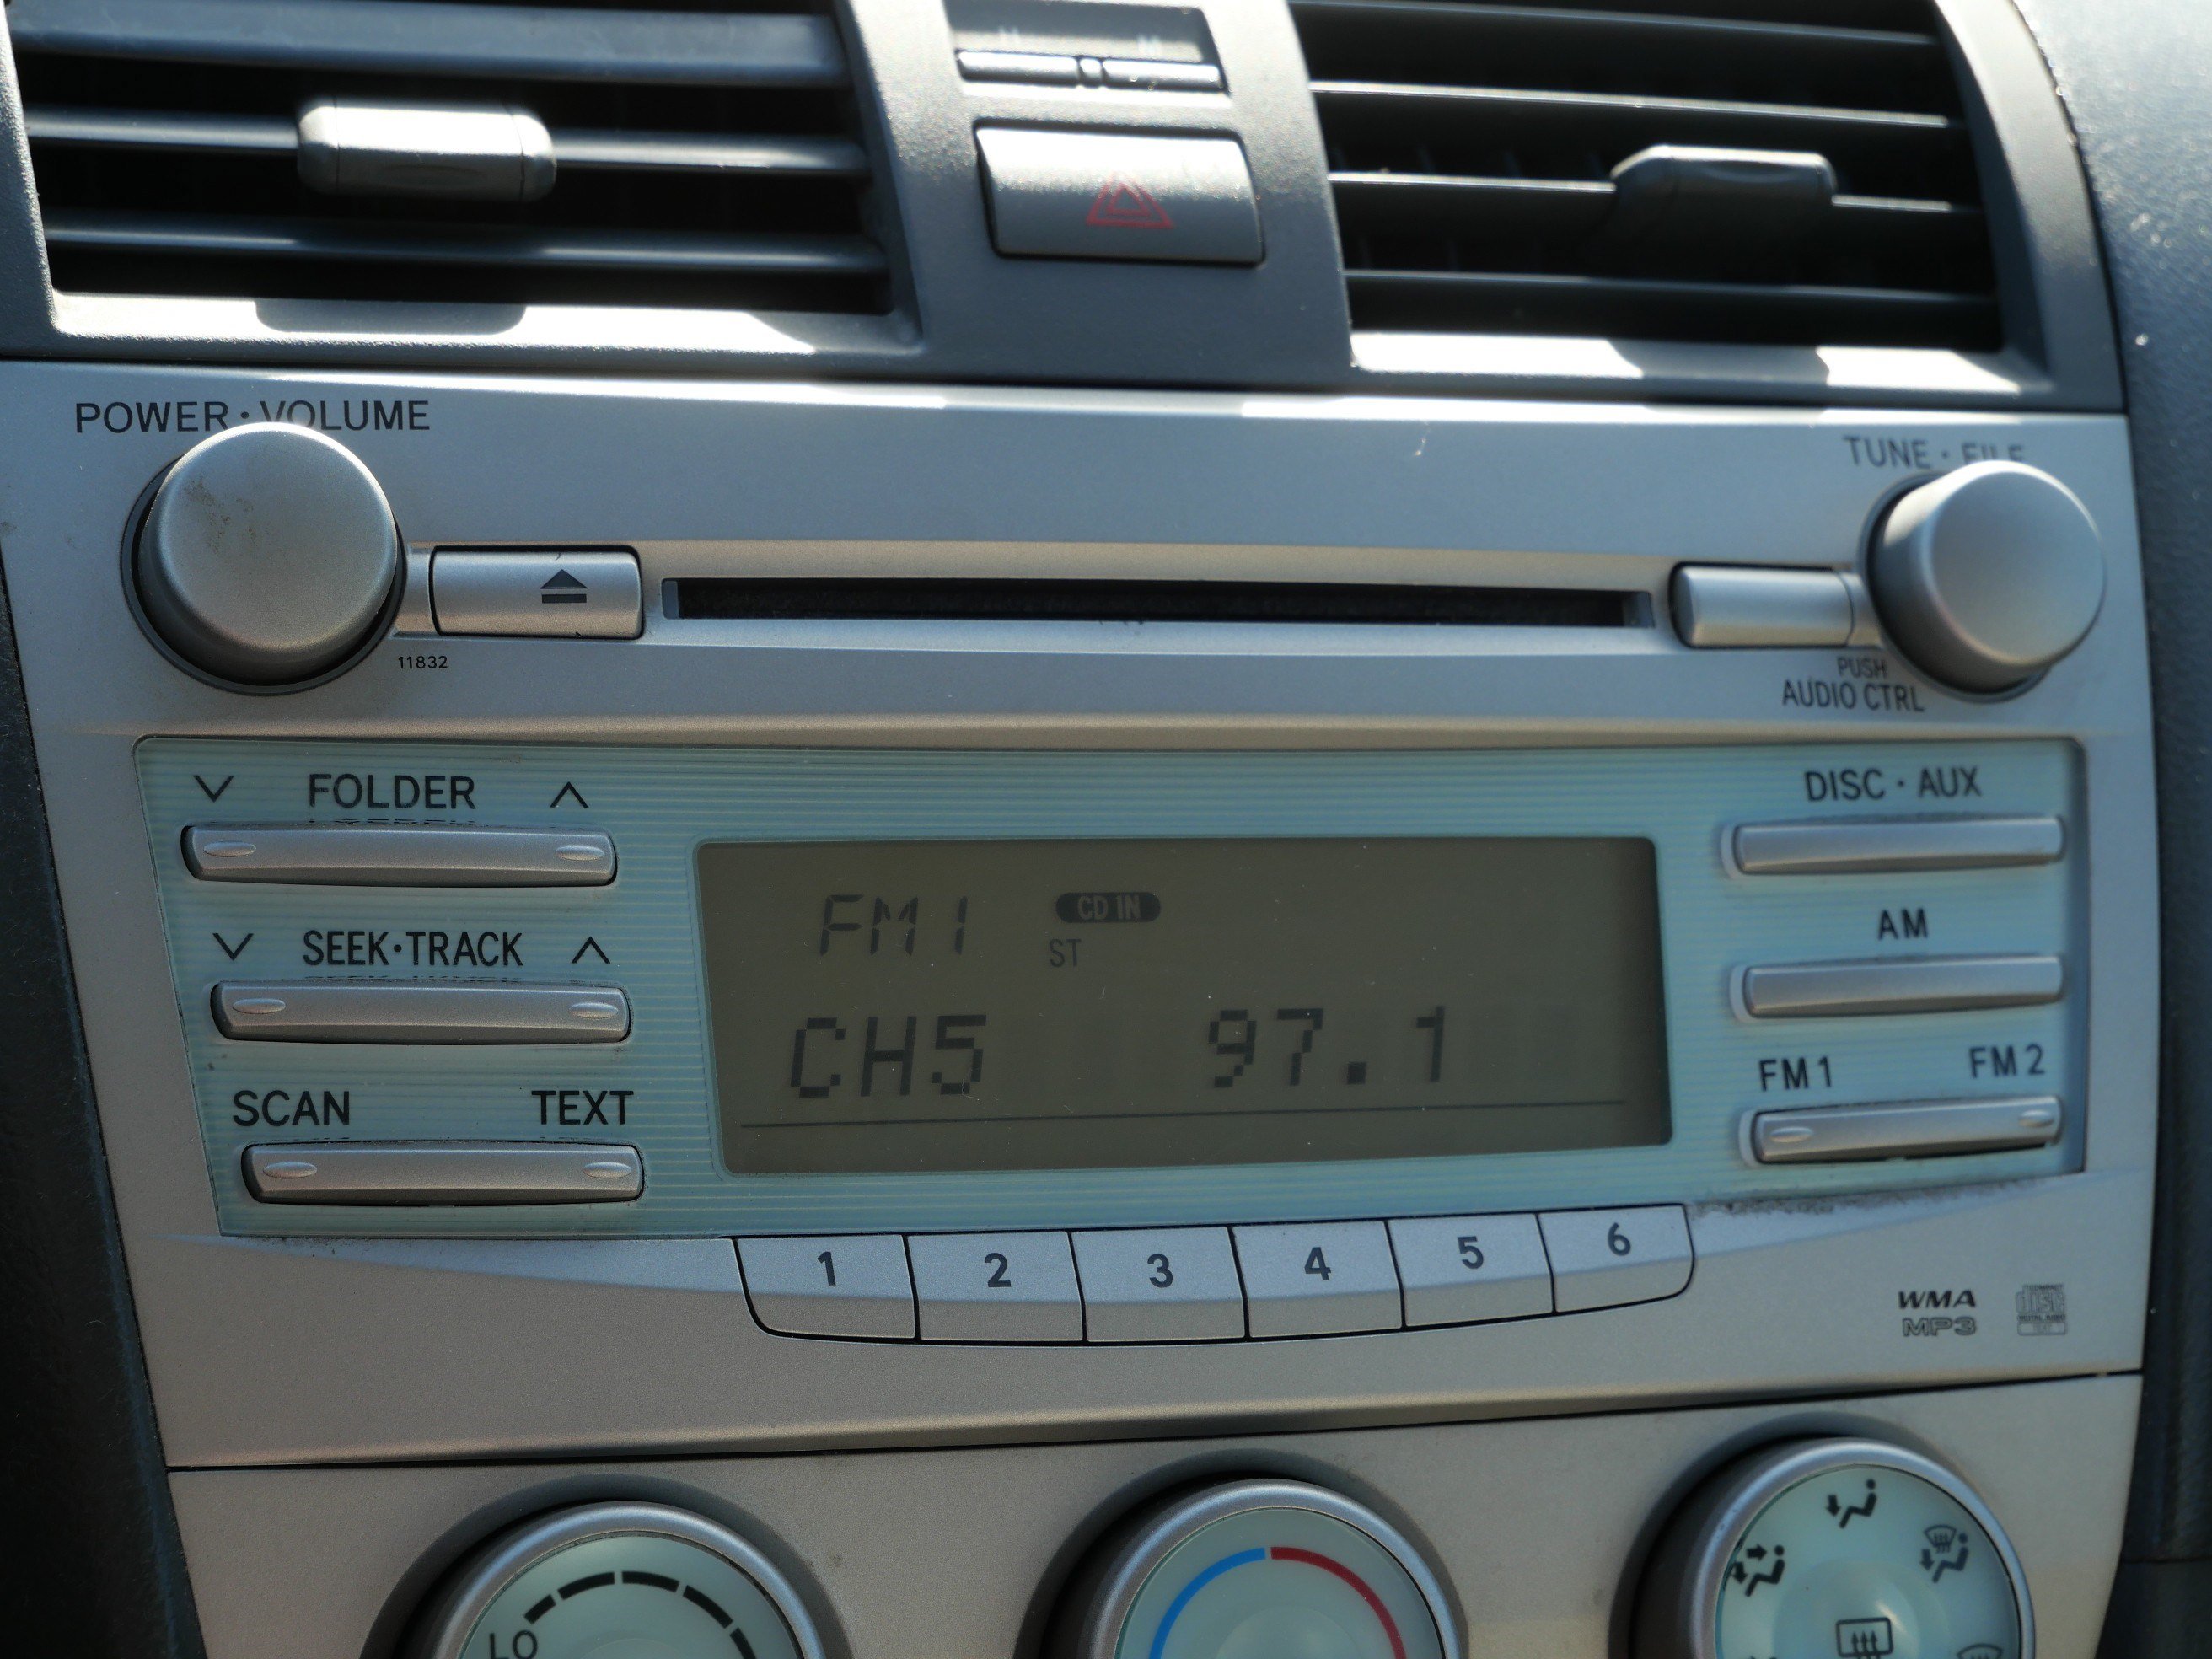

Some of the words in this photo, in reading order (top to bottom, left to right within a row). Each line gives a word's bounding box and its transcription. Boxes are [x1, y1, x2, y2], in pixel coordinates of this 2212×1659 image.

[397, 655, 448, 670] 11832
[1837, 657, 1888, 679] PUSH
[1782, 679, 1857, 710] AUDIO
[1863, 682, 1926, 712] CTRL
[308, 773, 477, 810] FOLDER
[1076, 894, 1109, 921] CD
[1115, 894, 1141, 920] IN
[1877, 907, 1928, 940] AM
[1048, 937, 1082, 968] ST
[789, 1013, 988, 1099] CH5
[1206, 1004, 1447, 1091] 97.1
[232, 1089, 351, 1127] SCAN
[530, 1089, 635, 1125] TEXT
[1457, 1235, 1485, 1270] 5
[1607, 1221, 1632, 1257] 6
[816, 1250, 838, 1286] 1
[983, 1252, 1012, 1289] 2
[1146, 1253, 1174, 1290] 3
[1302, 1245, 1333, 1282] 4
[1898, 1289, 1977, 1309] WMA
[1902, 1316, 1978, 1337] MP3
[489, 1630, 539, 1659] LO
